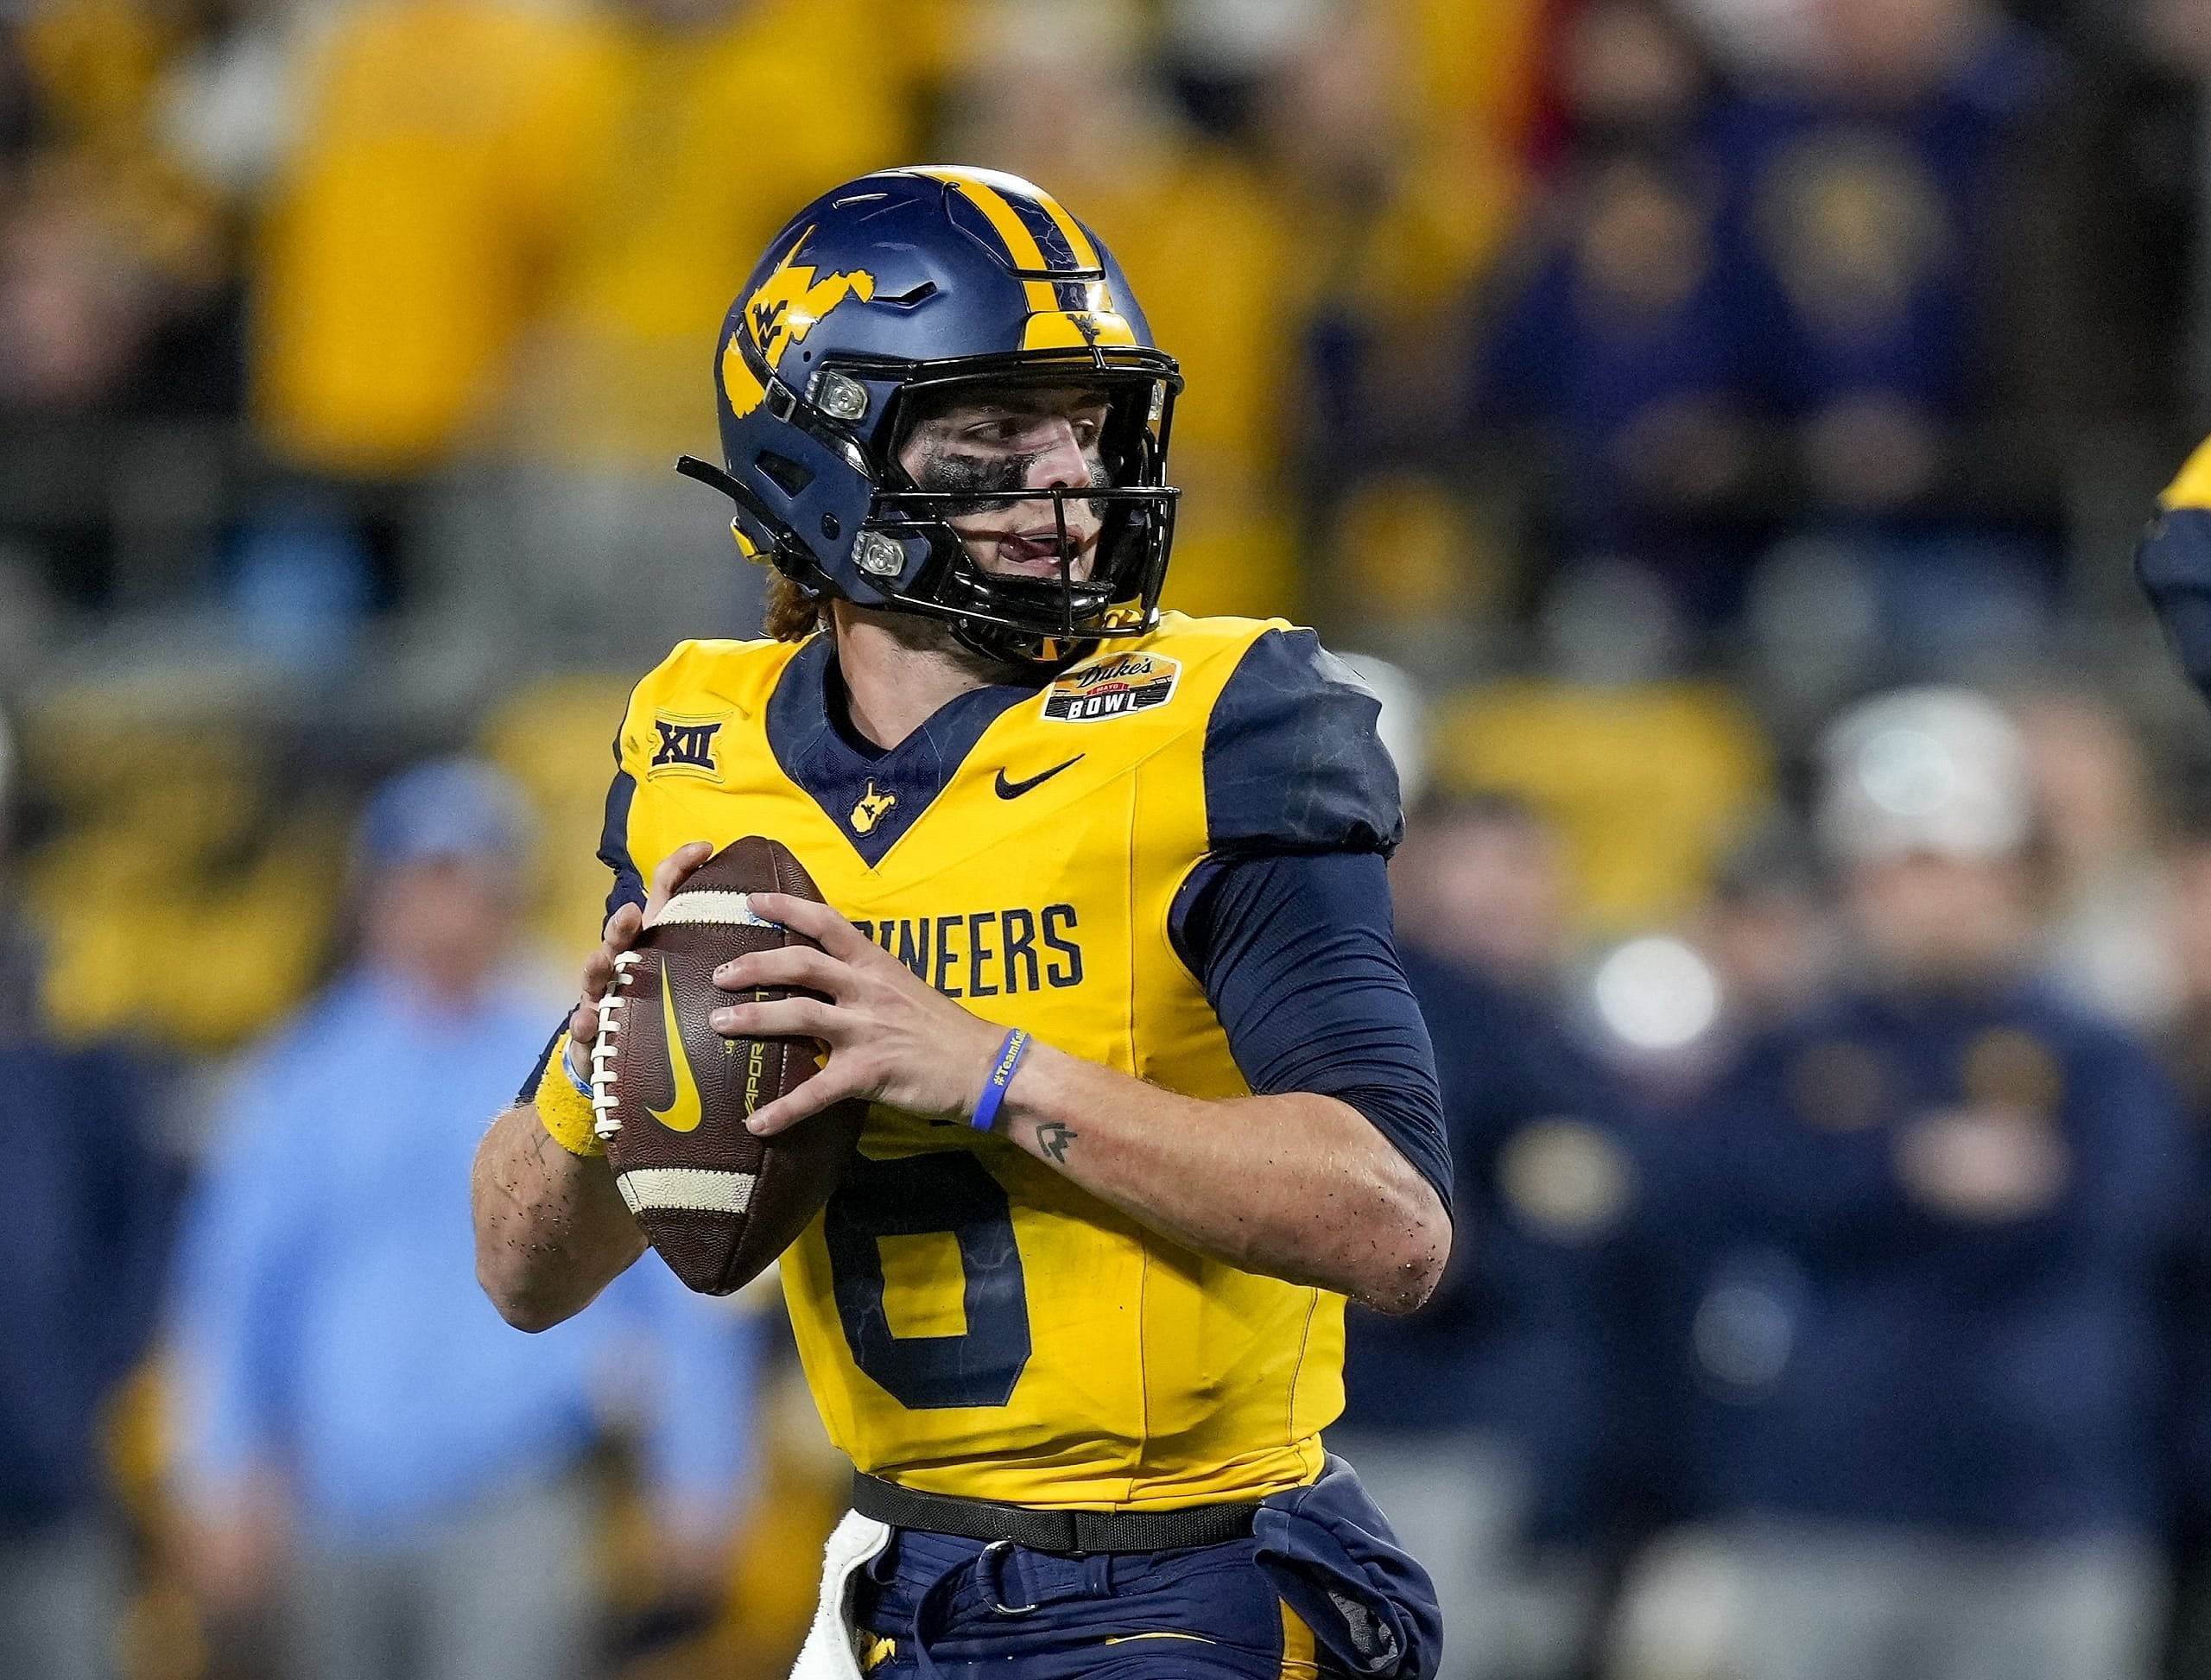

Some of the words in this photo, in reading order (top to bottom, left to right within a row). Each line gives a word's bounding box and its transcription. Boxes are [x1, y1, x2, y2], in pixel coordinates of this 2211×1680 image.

[1076, 658, 1152, 688] Duke's
[1098, 683, 1119, 692] MAYO
[1066, 692, 1139, 720] BOWL
[652, 720, 722, 770] XII
